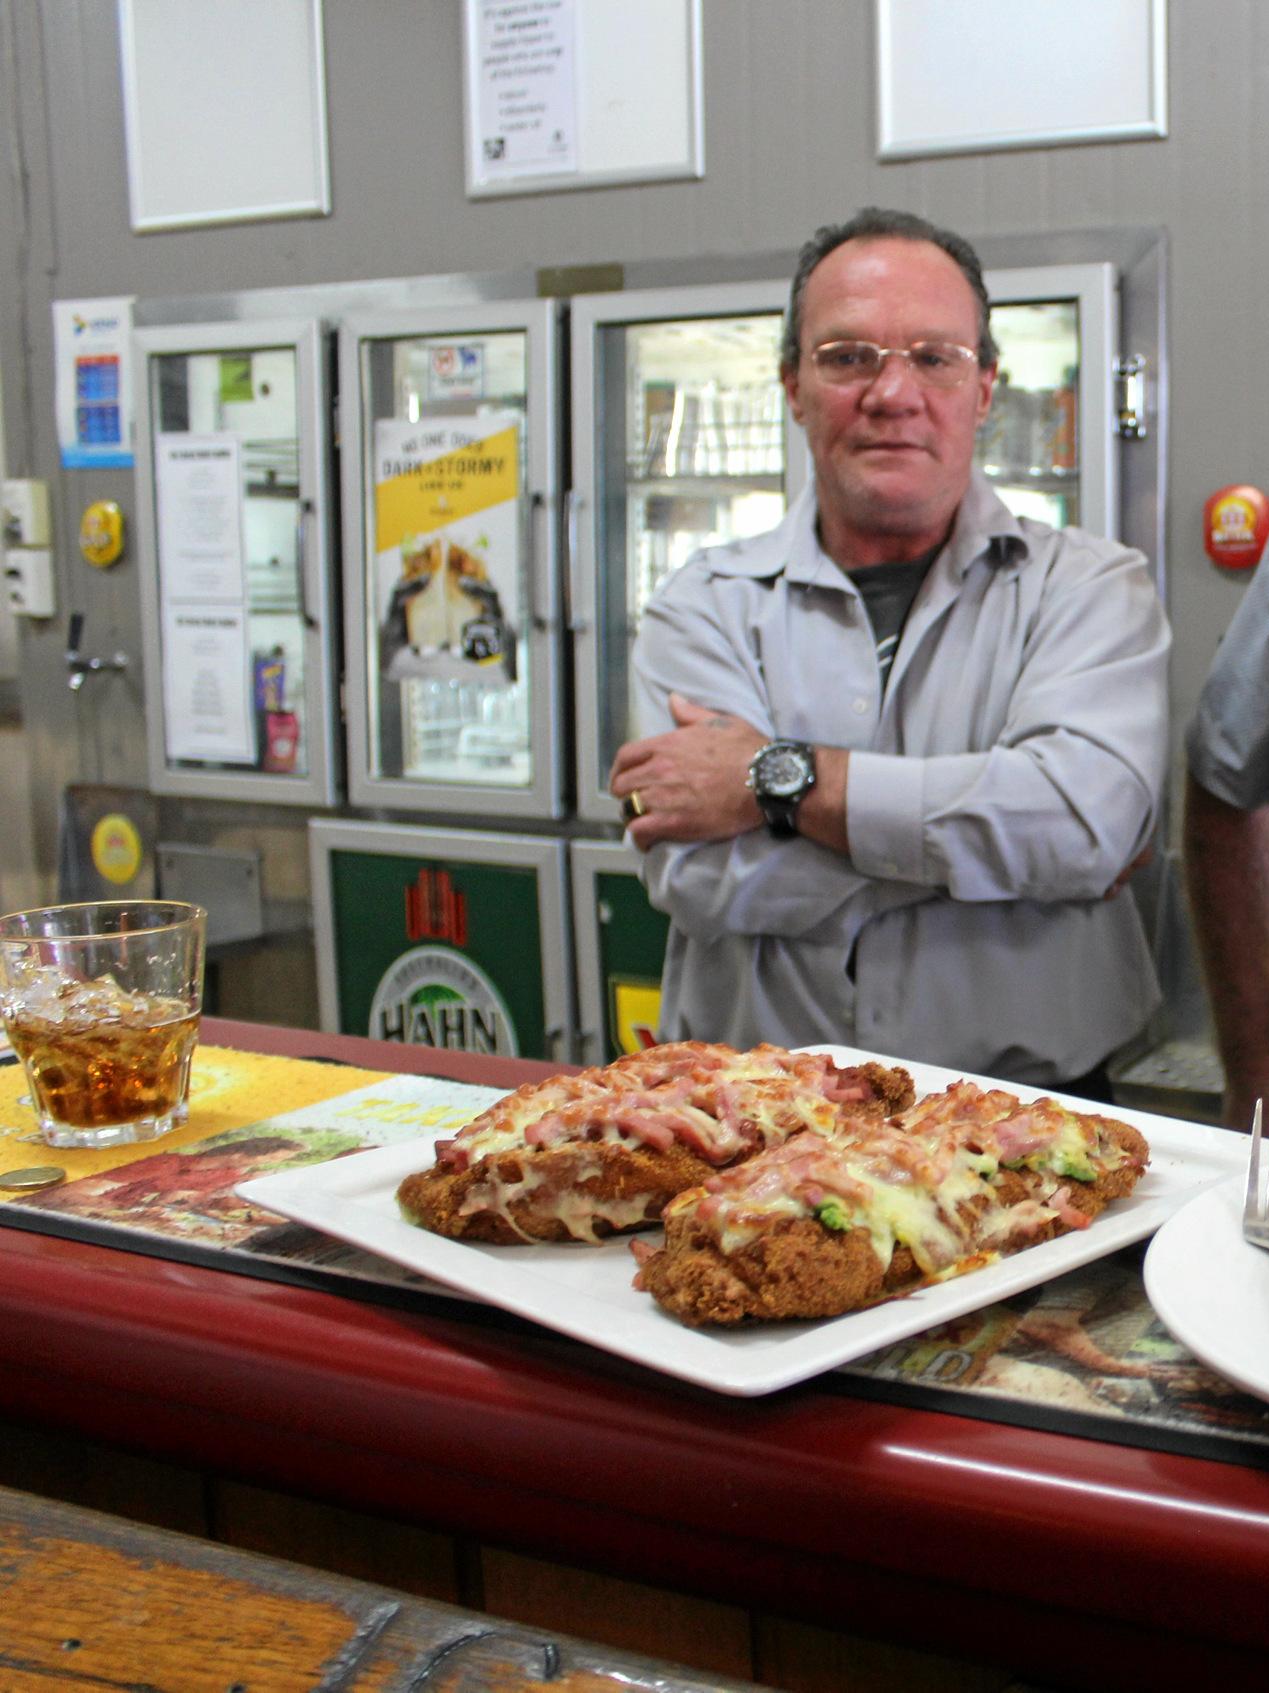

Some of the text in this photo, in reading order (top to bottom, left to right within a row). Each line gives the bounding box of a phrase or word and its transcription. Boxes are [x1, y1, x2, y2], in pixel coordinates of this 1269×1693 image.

[421, 432, 445, 448] ONE
[382, 456, 505, 477] DARK STORMY
[380, 1003, 496, 1053] HAHN
